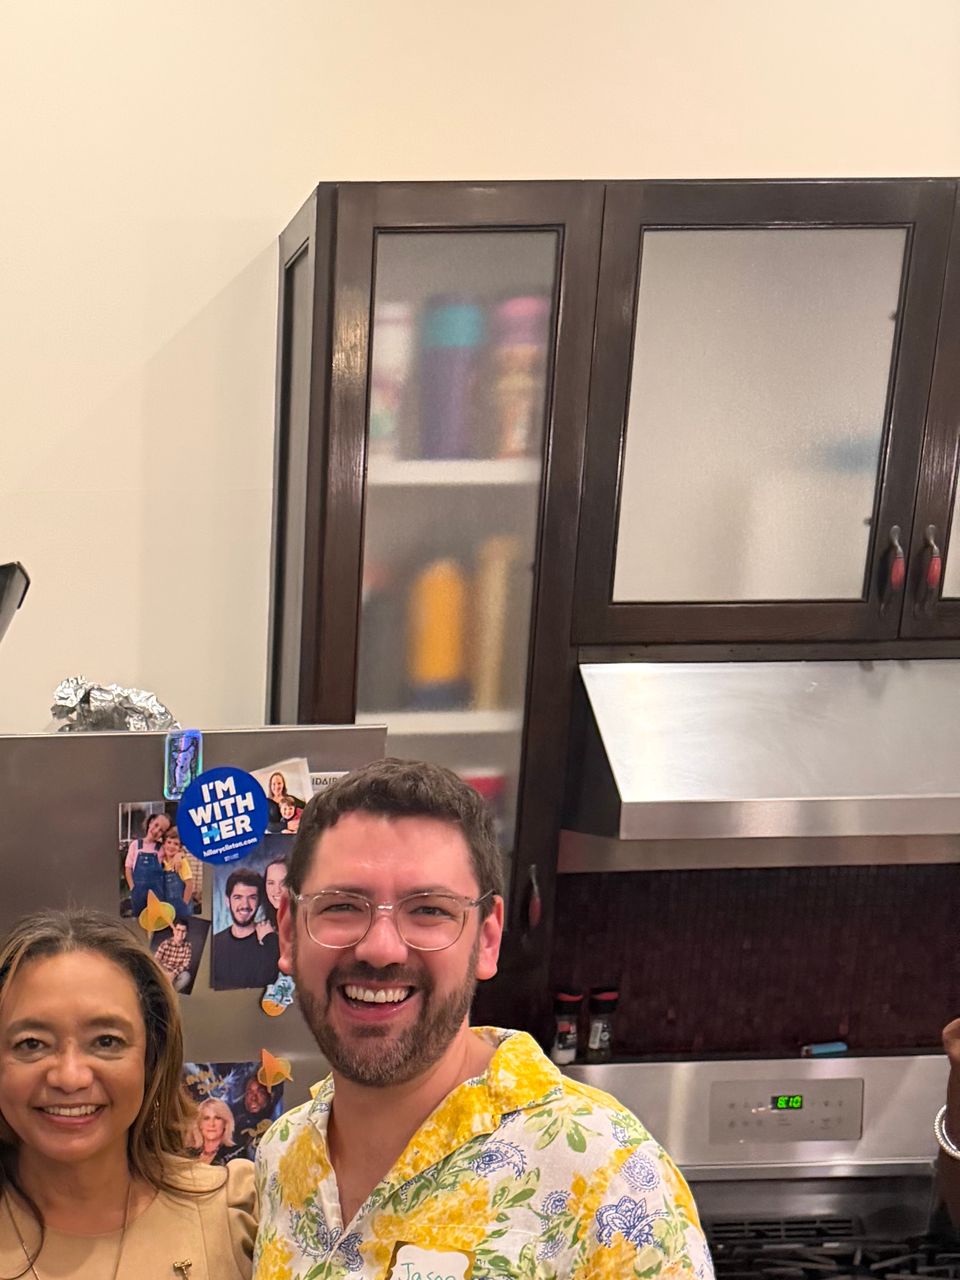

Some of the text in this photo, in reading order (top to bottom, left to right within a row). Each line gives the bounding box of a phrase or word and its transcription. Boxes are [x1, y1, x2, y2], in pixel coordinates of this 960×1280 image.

[201, 776, 236, 803] I'M
[188, 792, 255, 827] WITH
[200, 814, 253, 845] HER
